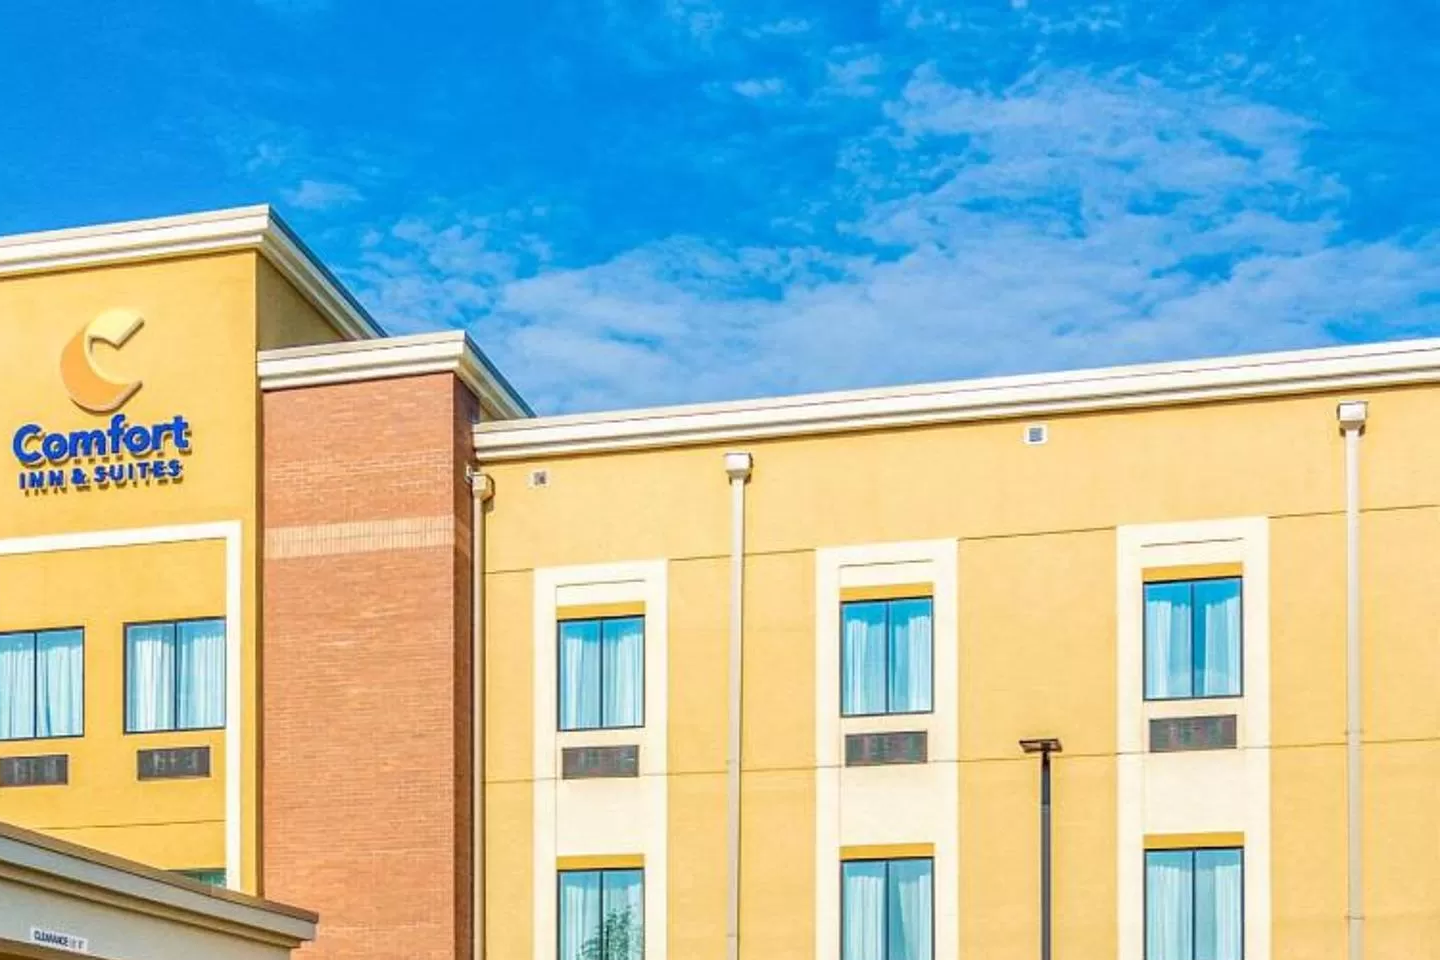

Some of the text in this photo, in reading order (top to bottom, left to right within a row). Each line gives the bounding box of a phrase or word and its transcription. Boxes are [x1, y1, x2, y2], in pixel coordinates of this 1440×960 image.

[12, 414, 191, 466] Comfort
[19, 458, 183, 491] INN & SUITES
